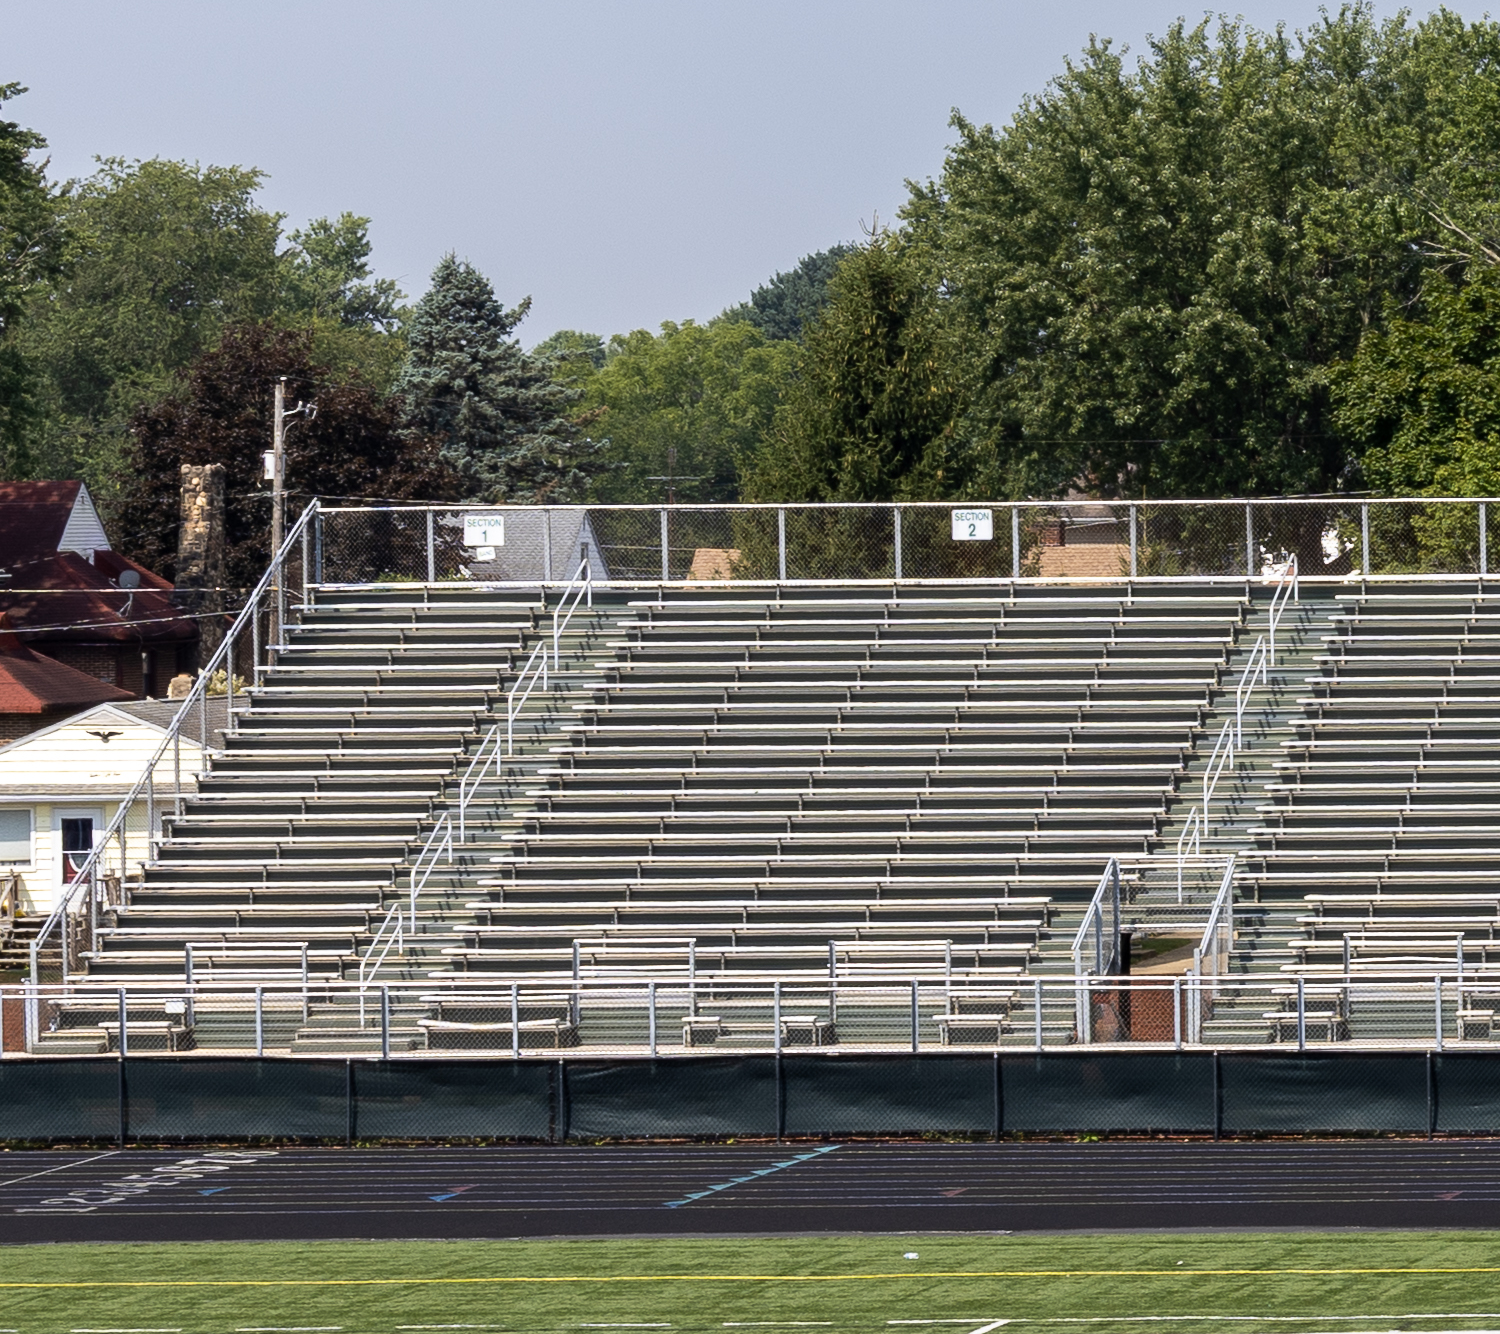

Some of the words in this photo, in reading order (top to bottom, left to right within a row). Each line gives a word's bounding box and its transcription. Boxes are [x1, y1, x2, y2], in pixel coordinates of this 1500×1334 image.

[954, 511, 990, 521] SECTION
[466, 518, 501, 528] SECTION
[481, 529, 488, 543] 1
[968, 523, 976, 537] 2
